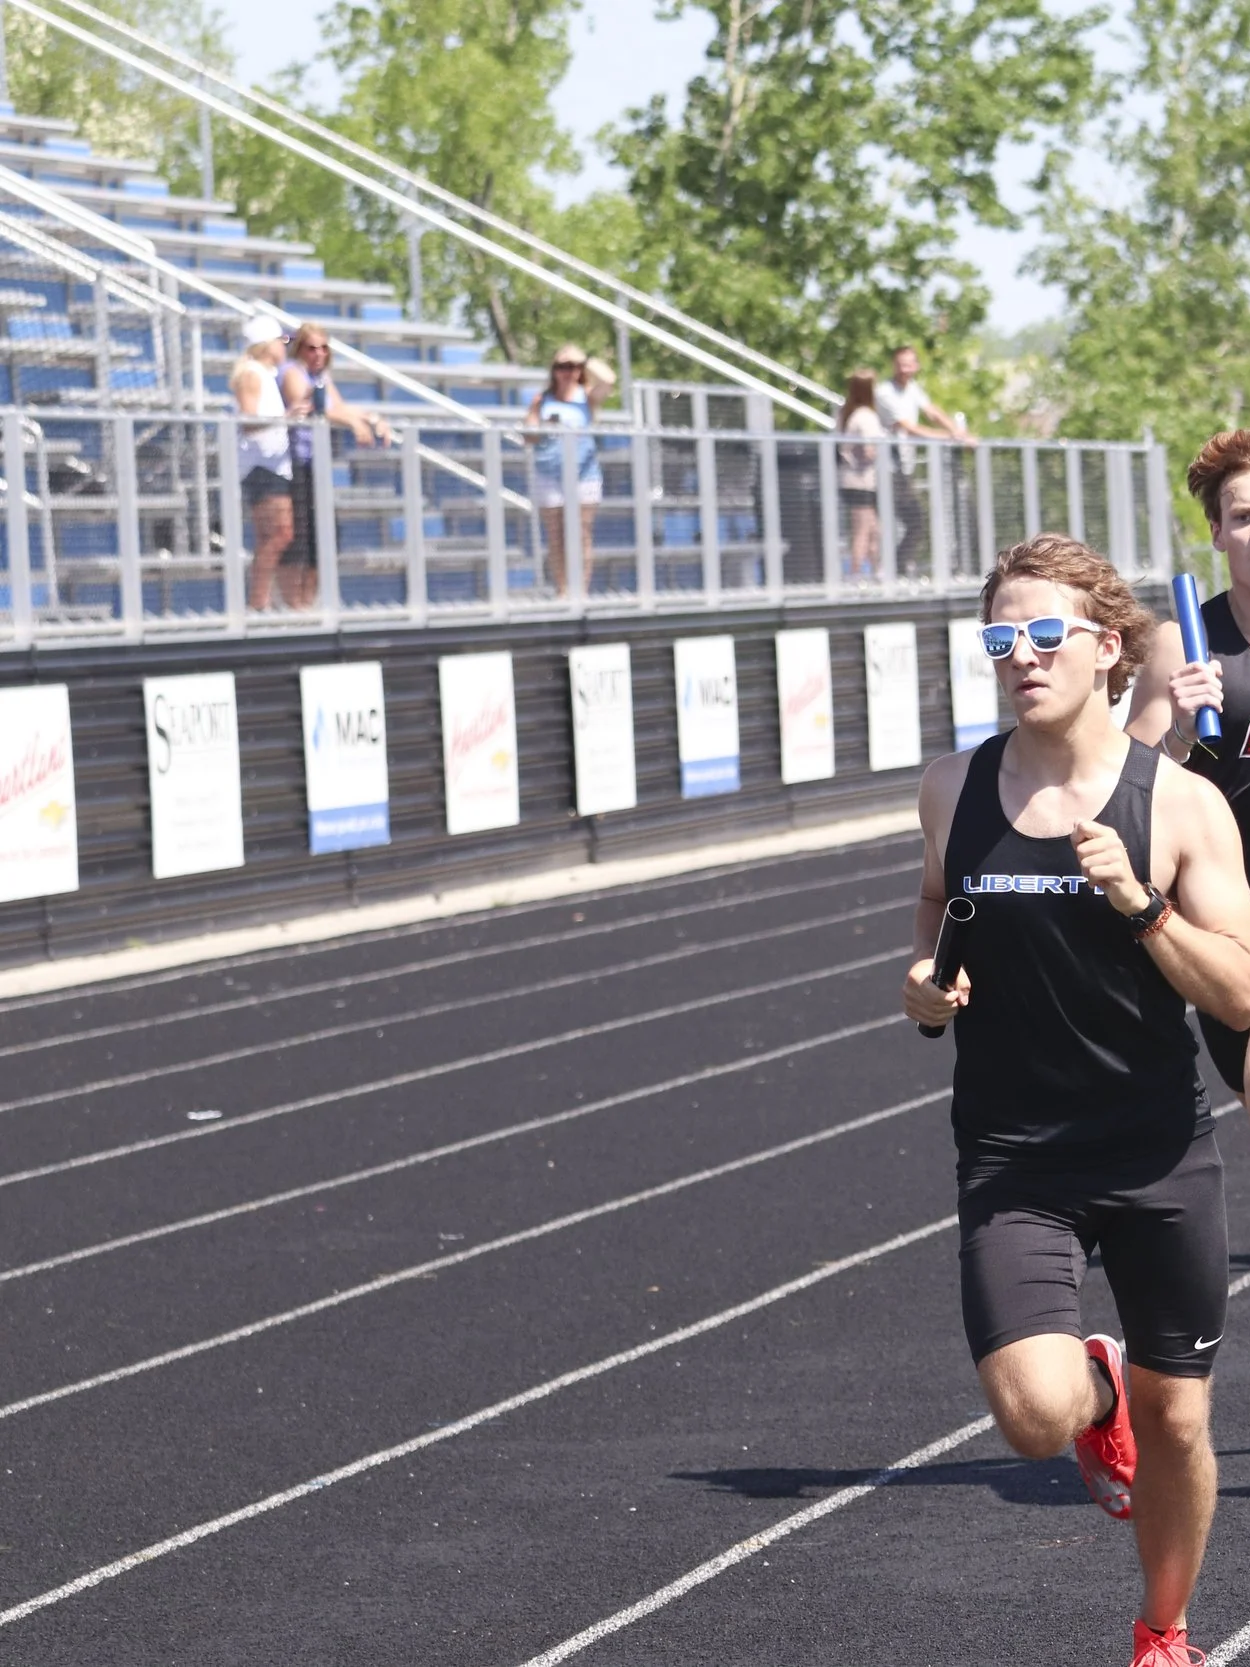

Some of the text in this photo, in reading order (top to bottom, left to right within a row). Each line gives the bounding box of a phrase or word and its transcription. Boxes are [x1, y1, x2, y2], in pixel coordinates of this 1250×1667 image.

[154, 694, 231, 775] SEAPORT
[334, 708, 382, 748] MAC
[963, 874, 1105, 895] LIBERT
